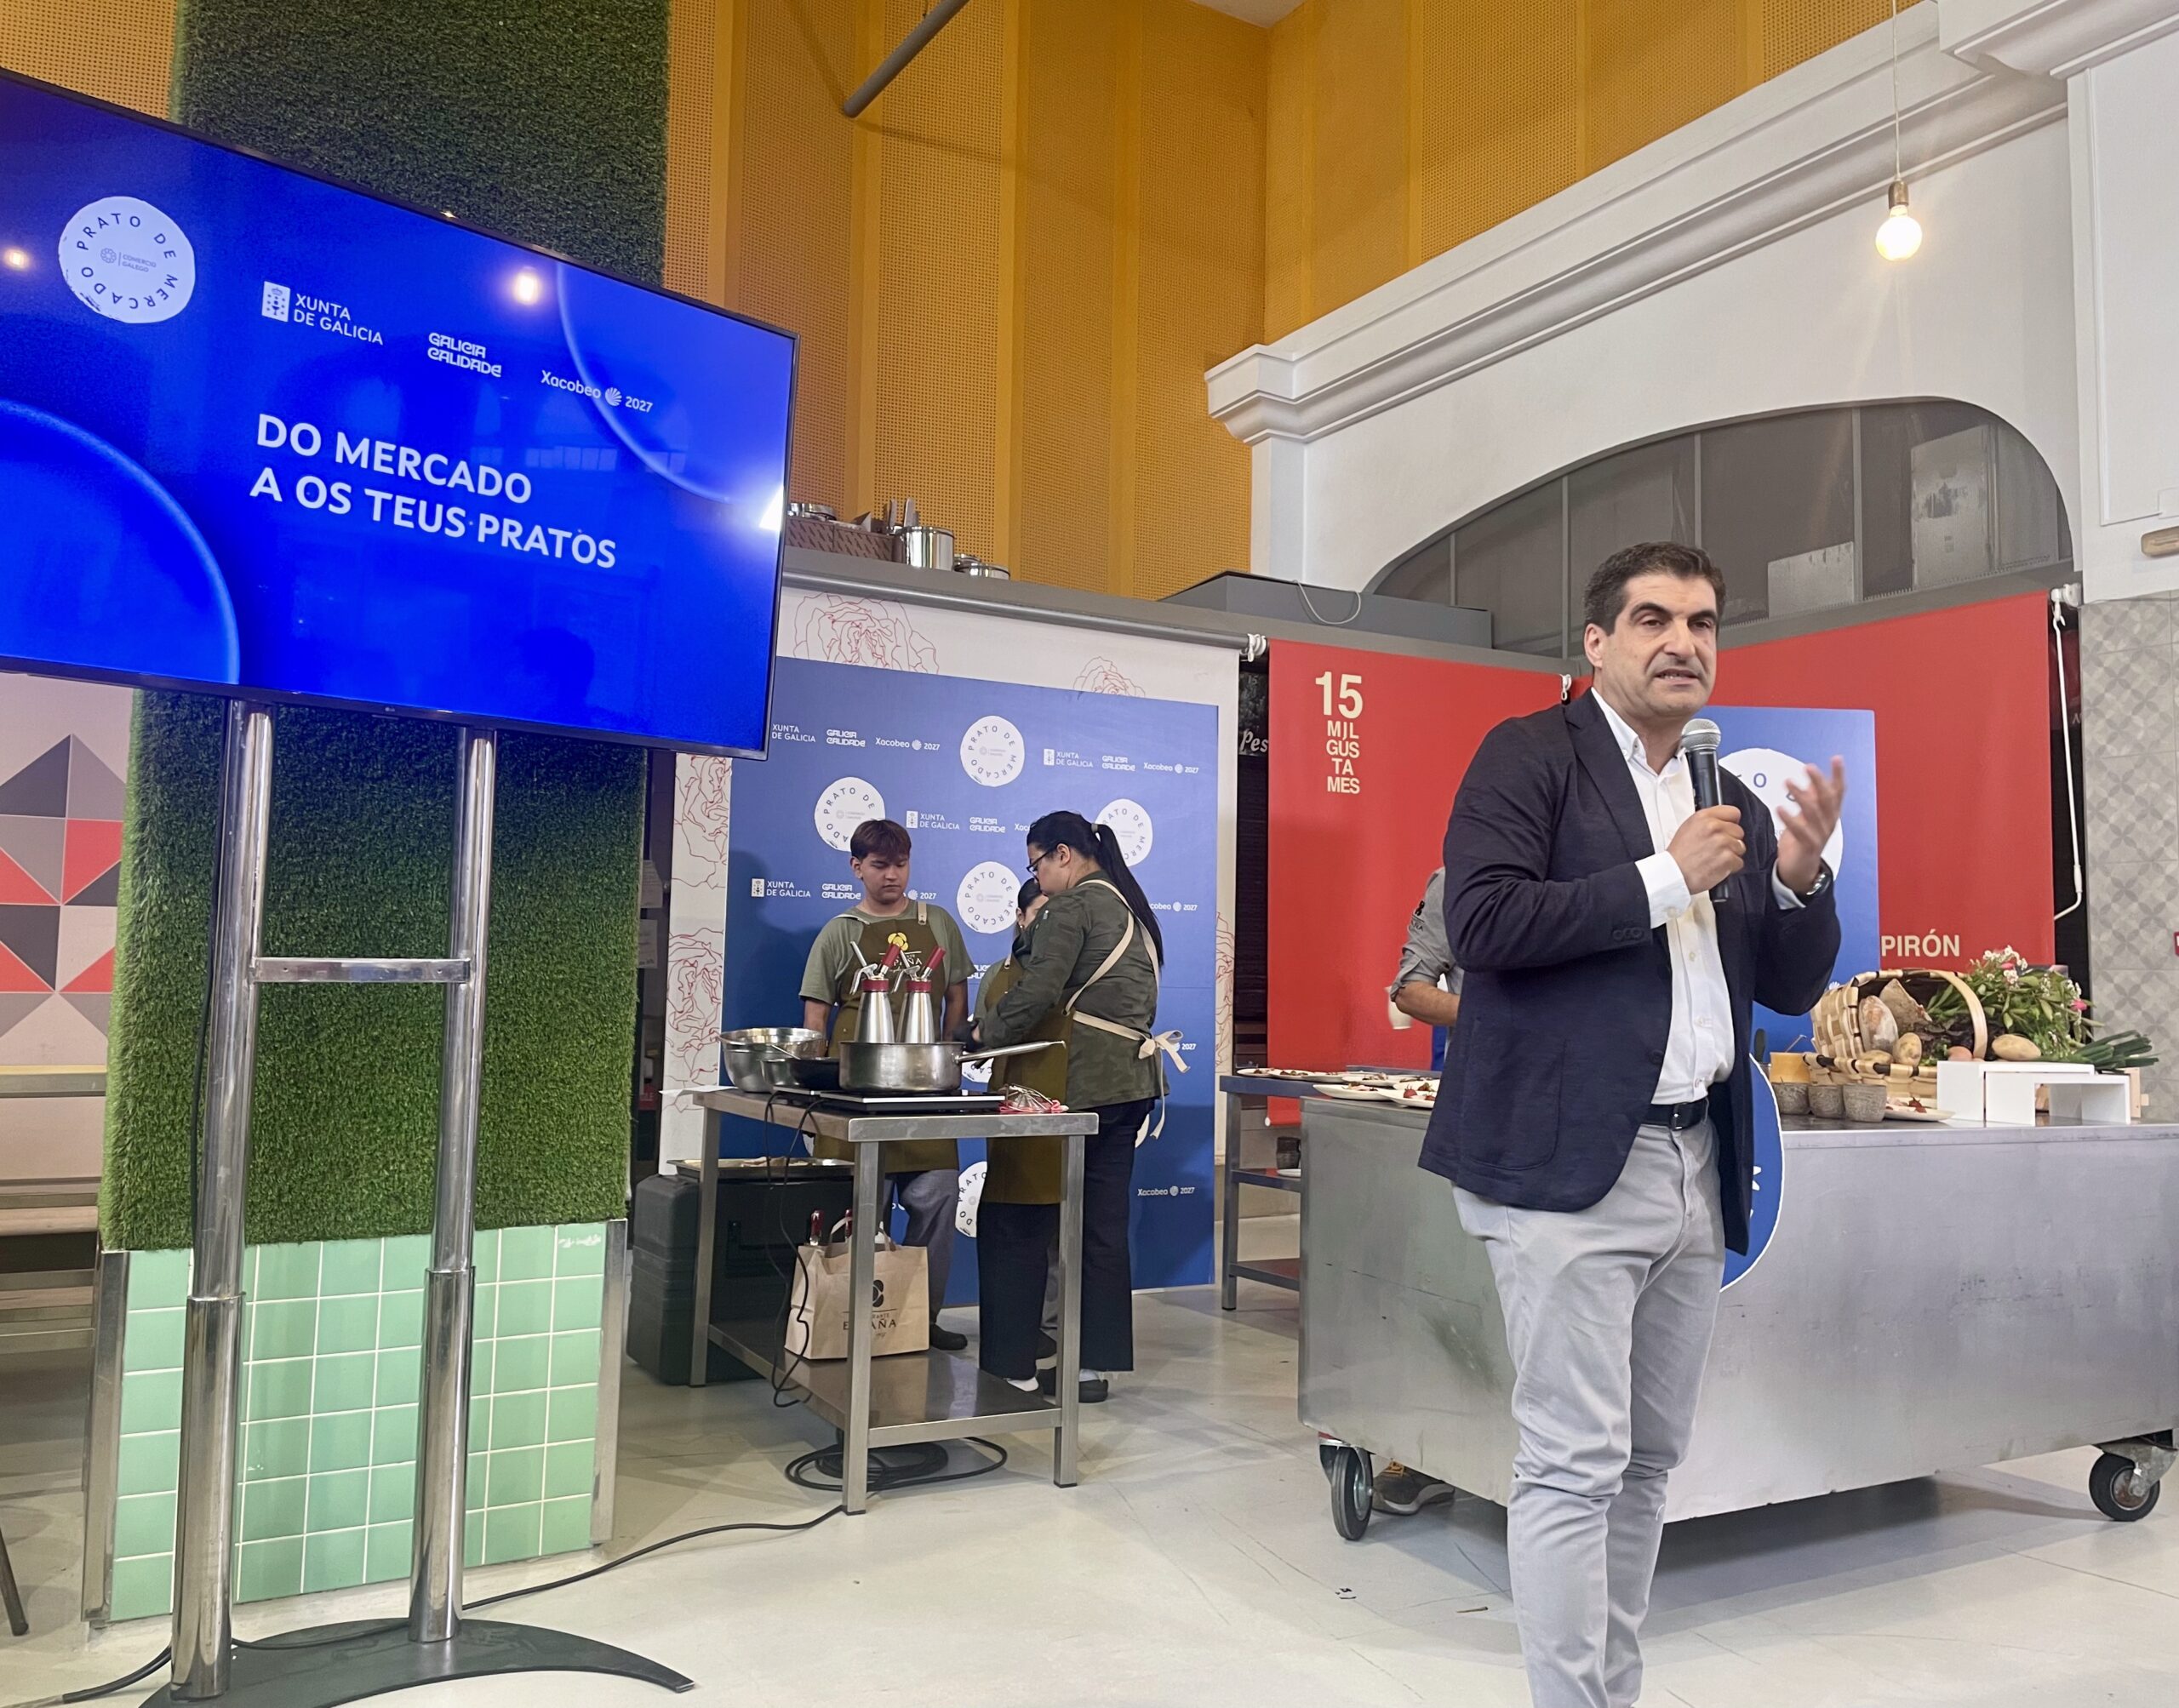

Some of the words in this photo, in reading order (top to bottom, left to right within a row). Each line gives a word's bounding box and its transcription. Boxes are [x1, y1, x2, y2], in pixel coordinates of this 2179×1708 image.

[77, 213, 140, 250] PRATO
[154, 233, 177, 259] DE
[81, 266, 178, 310] MERCADO
[295, 292, 352, 321] XUNTA
[294, 308, 315, 328] DE
[319, 316, 384, 346] GALICIA
[540, 369, 602, 399] Xacobeo
[625, 395, 654, 414] 2027
[257, 413, 322, 456] DO
[335, 431, 532, 504] MERCADO
[249, 467, 283, 502] A
[295, 475, 352, 515] OS
[363, 488, 466, 538] TEUS
[478, 513, 617, 568] PRATOS
[1315, 671, 1364, 719] 15
[771, 732, 782, 740] DE
[784, 733, 816, 743] GALICIA
[772, 723, 800, 734] XUNTA
[968, 725, 998, 751] PRATO
[875, 737, 910, 749] Xacobeo
[924, 742, 941, 751] 2027
[1004, 732, 1015, 746] DE
[1326, 739, 1360, 758] GUS
[971, 755, 1016, 779] MERCADO
[1066, 759, 1094, 768] GALICIA
[1143, 762, 1173, 773] Xacobeo
[1185, 765, 1199, 774] 2027
[1331, 757, 1354, 775] TA
[1327, 776, 1360, 794] MES
[823, 786, 856, 814] PRATO
[862, 794, 875, 809] DE
[920, 813, 945, 821] XUNTA
[931, 821, 960, 830] GALICIA
[1102, 808, 1128, 825] RATO
[1133, 814, 1144, 829] DE
[1124, 836, 1146, 860] MERC
[767, 880, 795, 889] XUNTA
[779, 889, 811, 898] GALICIA
[964, 871, 994, 898] PRATO
[1001, 877, 1012, 892] DE
[968, 900, 1014, 925] MERCADO
[1150, 902, 1171, 911] cobeo
[1183, 903, 1198, 911] 2027
[1881, 928, 1960, 957] PIRÓN
